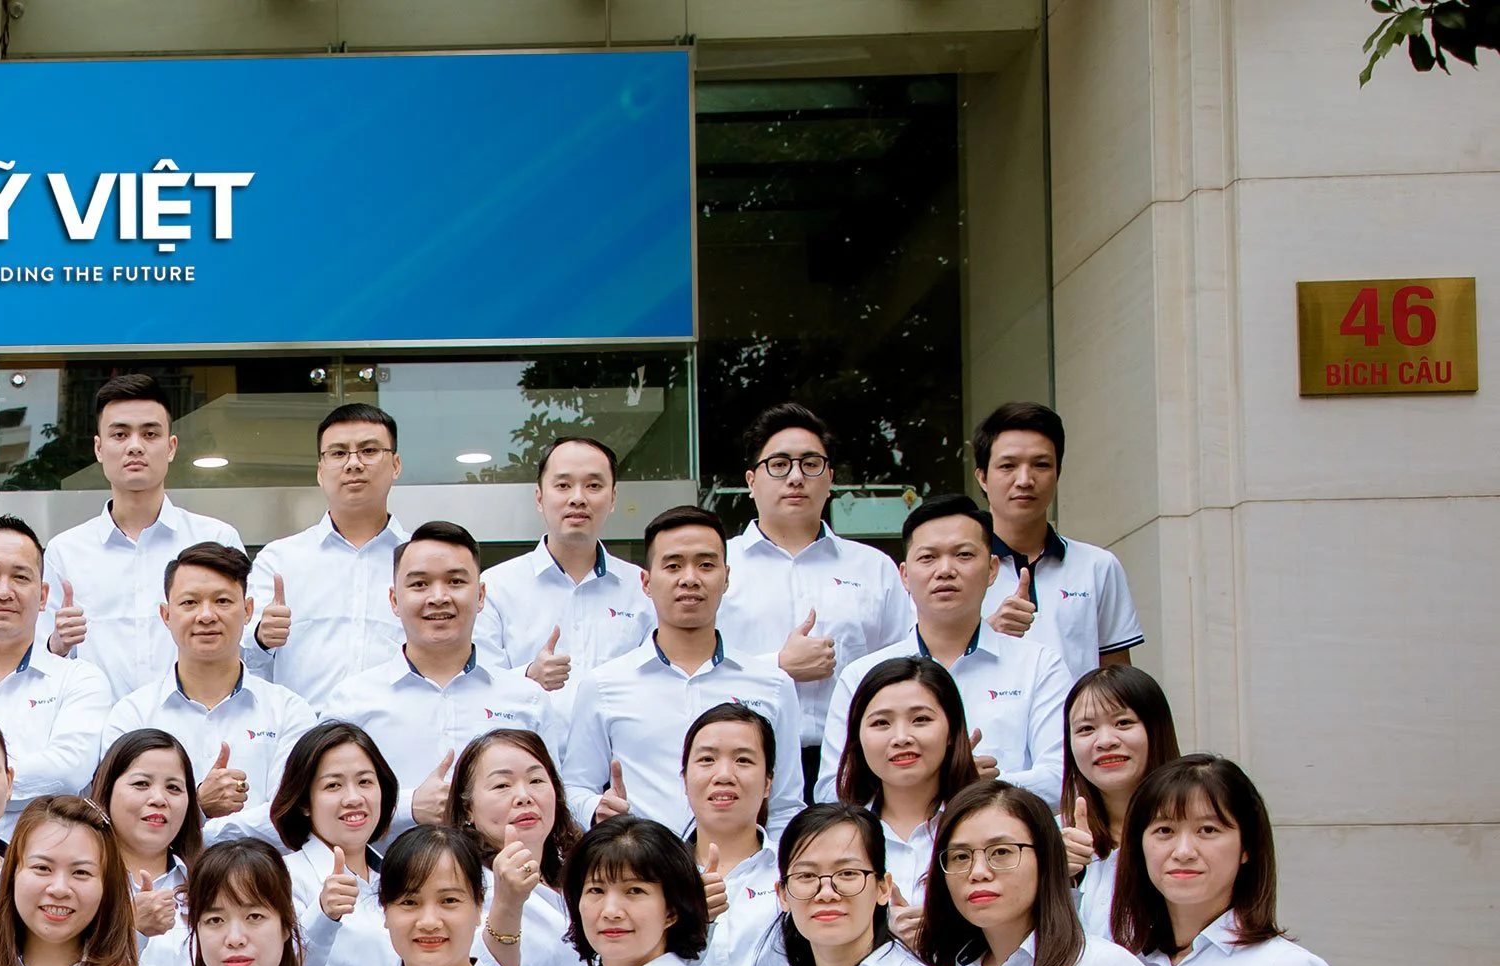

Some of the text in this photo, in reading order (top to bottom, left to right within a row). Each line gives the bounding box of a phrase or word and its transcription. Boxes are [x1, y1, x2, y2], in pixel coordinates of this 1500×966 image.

[47, 159, 256, 252] VIỆT
[63, 266, 103, 282] THE
[113, 266, 195, 282] FUTURE
[1340, 286, 1436, 347] 46
[1326, 356, 1452, 386] BÍCH CÂU
